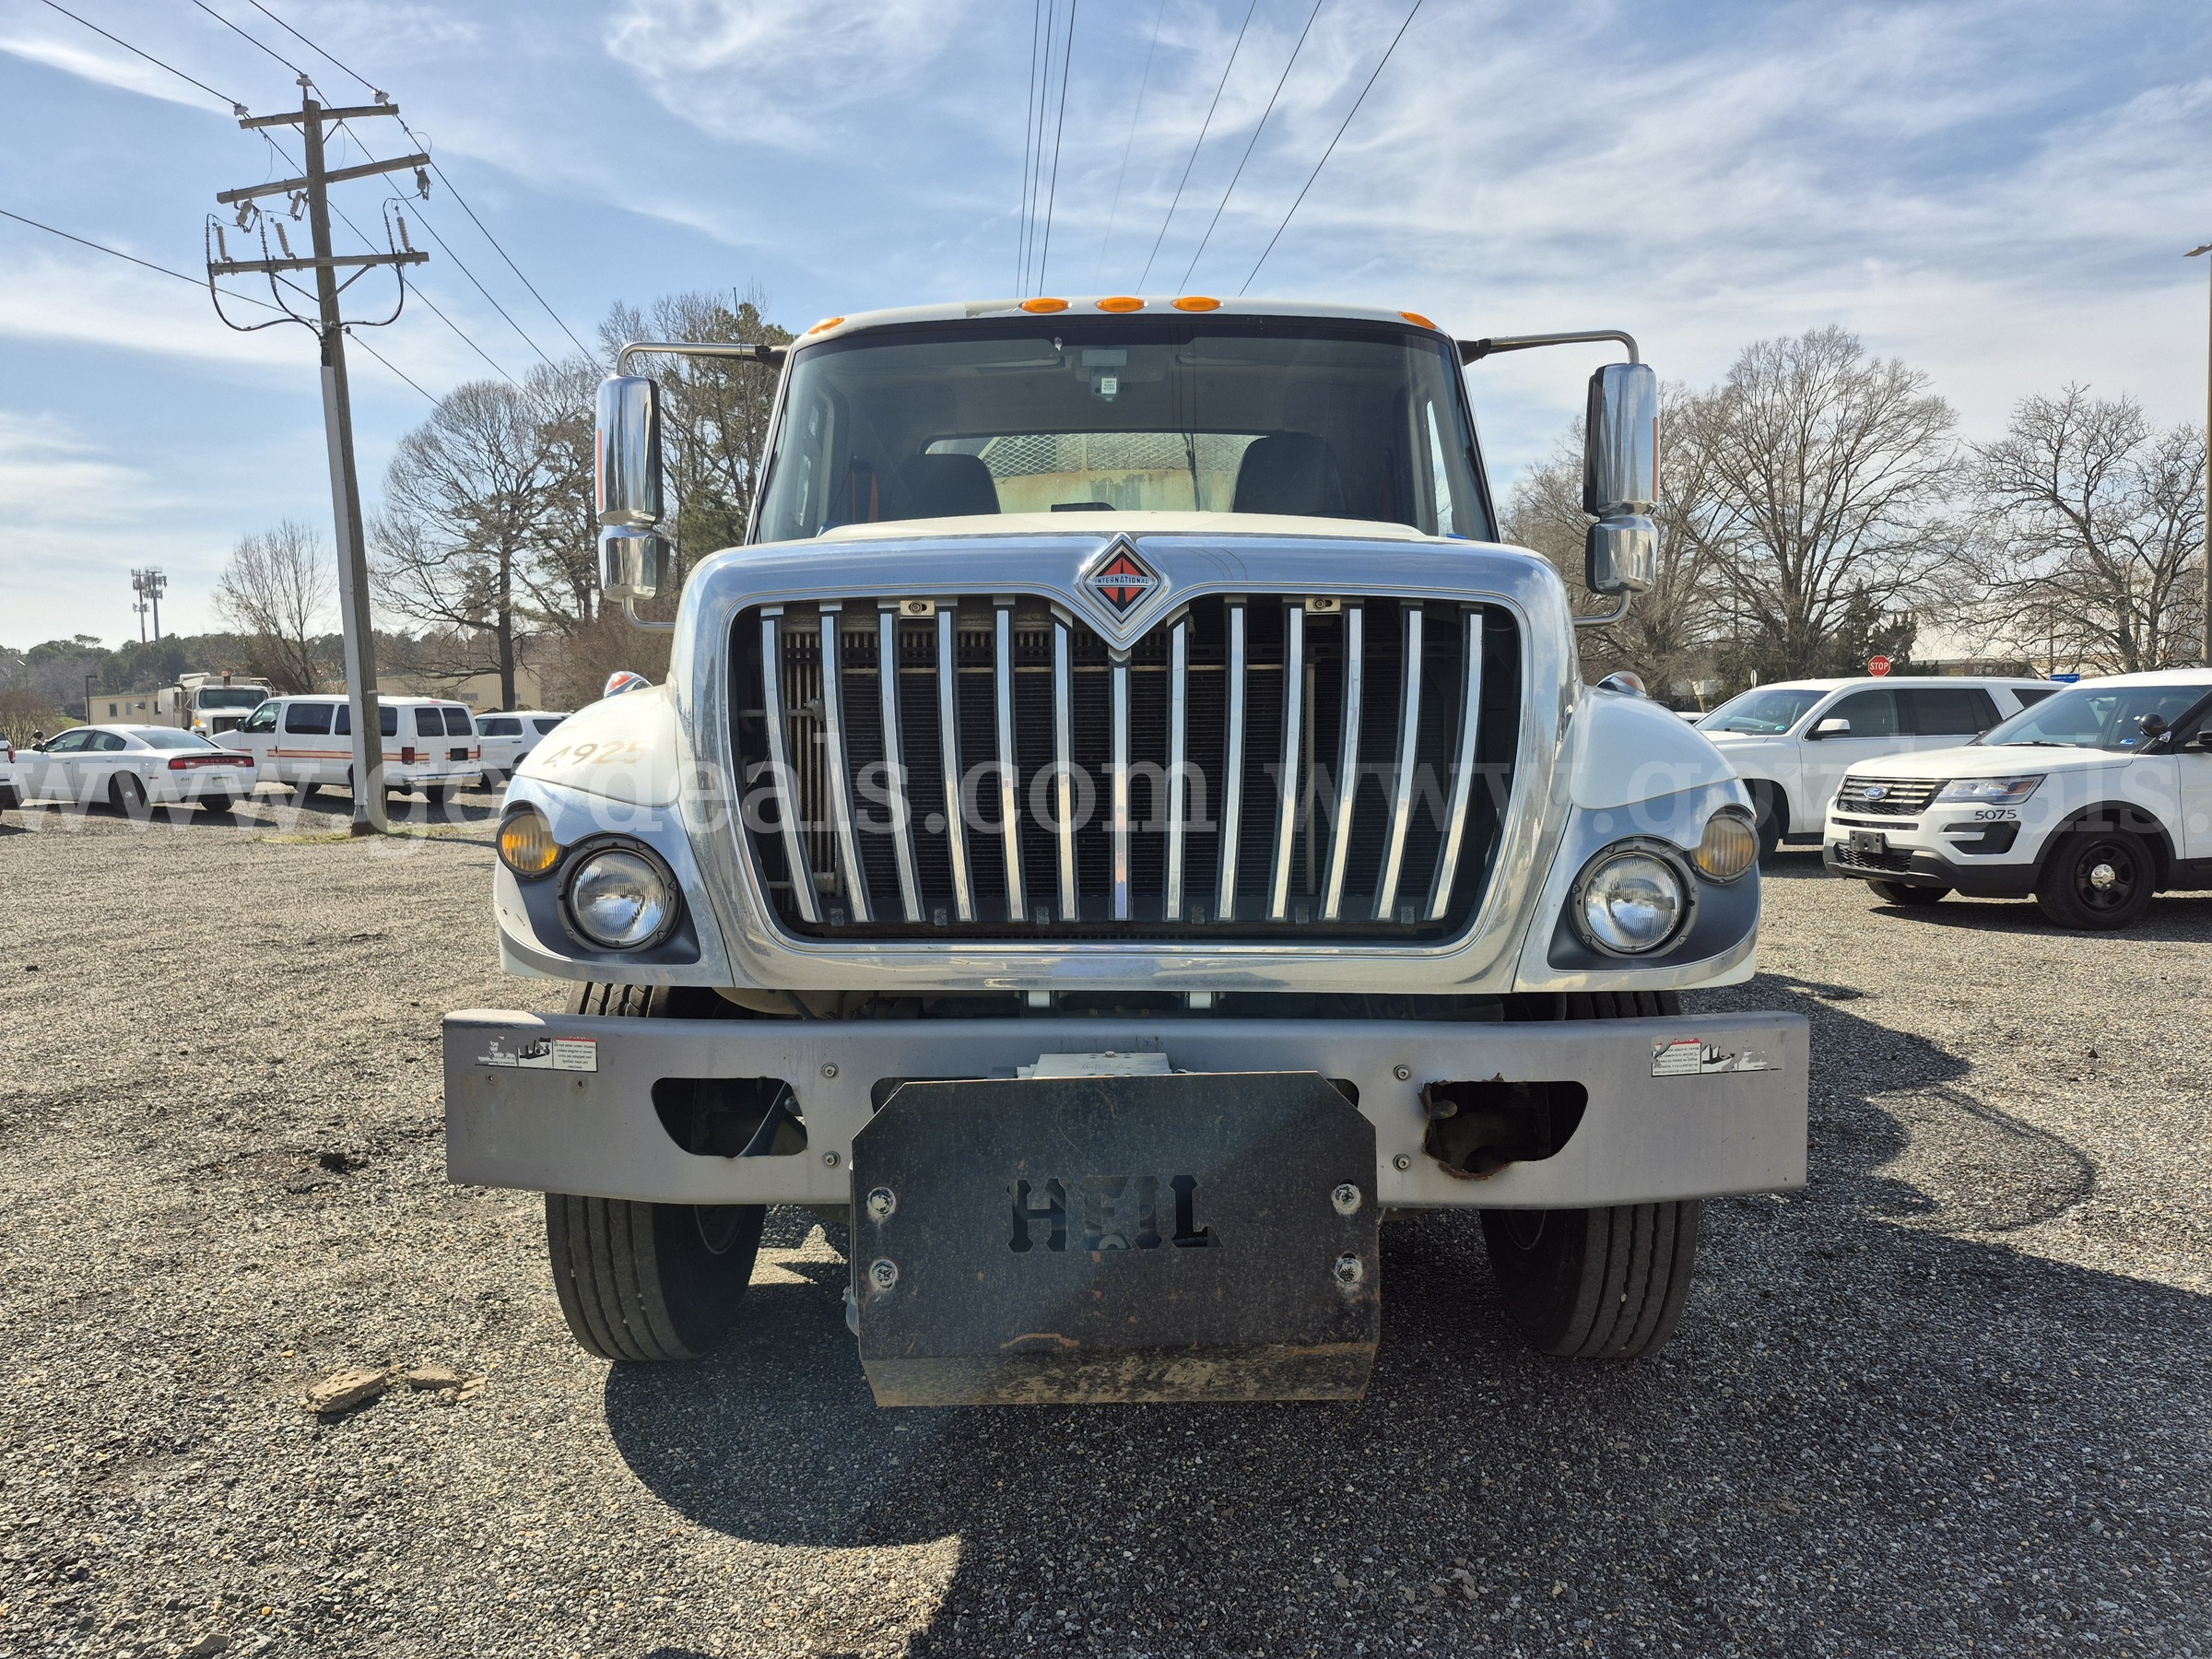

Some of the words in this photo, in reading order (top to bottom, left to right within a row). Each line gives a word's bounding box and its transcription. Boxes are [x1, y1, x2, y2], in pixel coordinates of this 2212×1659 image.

[1095, 575, 1148, 584] INTERNATIONAL
[1870, 662, 1888, 670] STOP
[1974, 809, 2017, 820] 5075
[1006, 1174, 1224, 1253] HEIL
